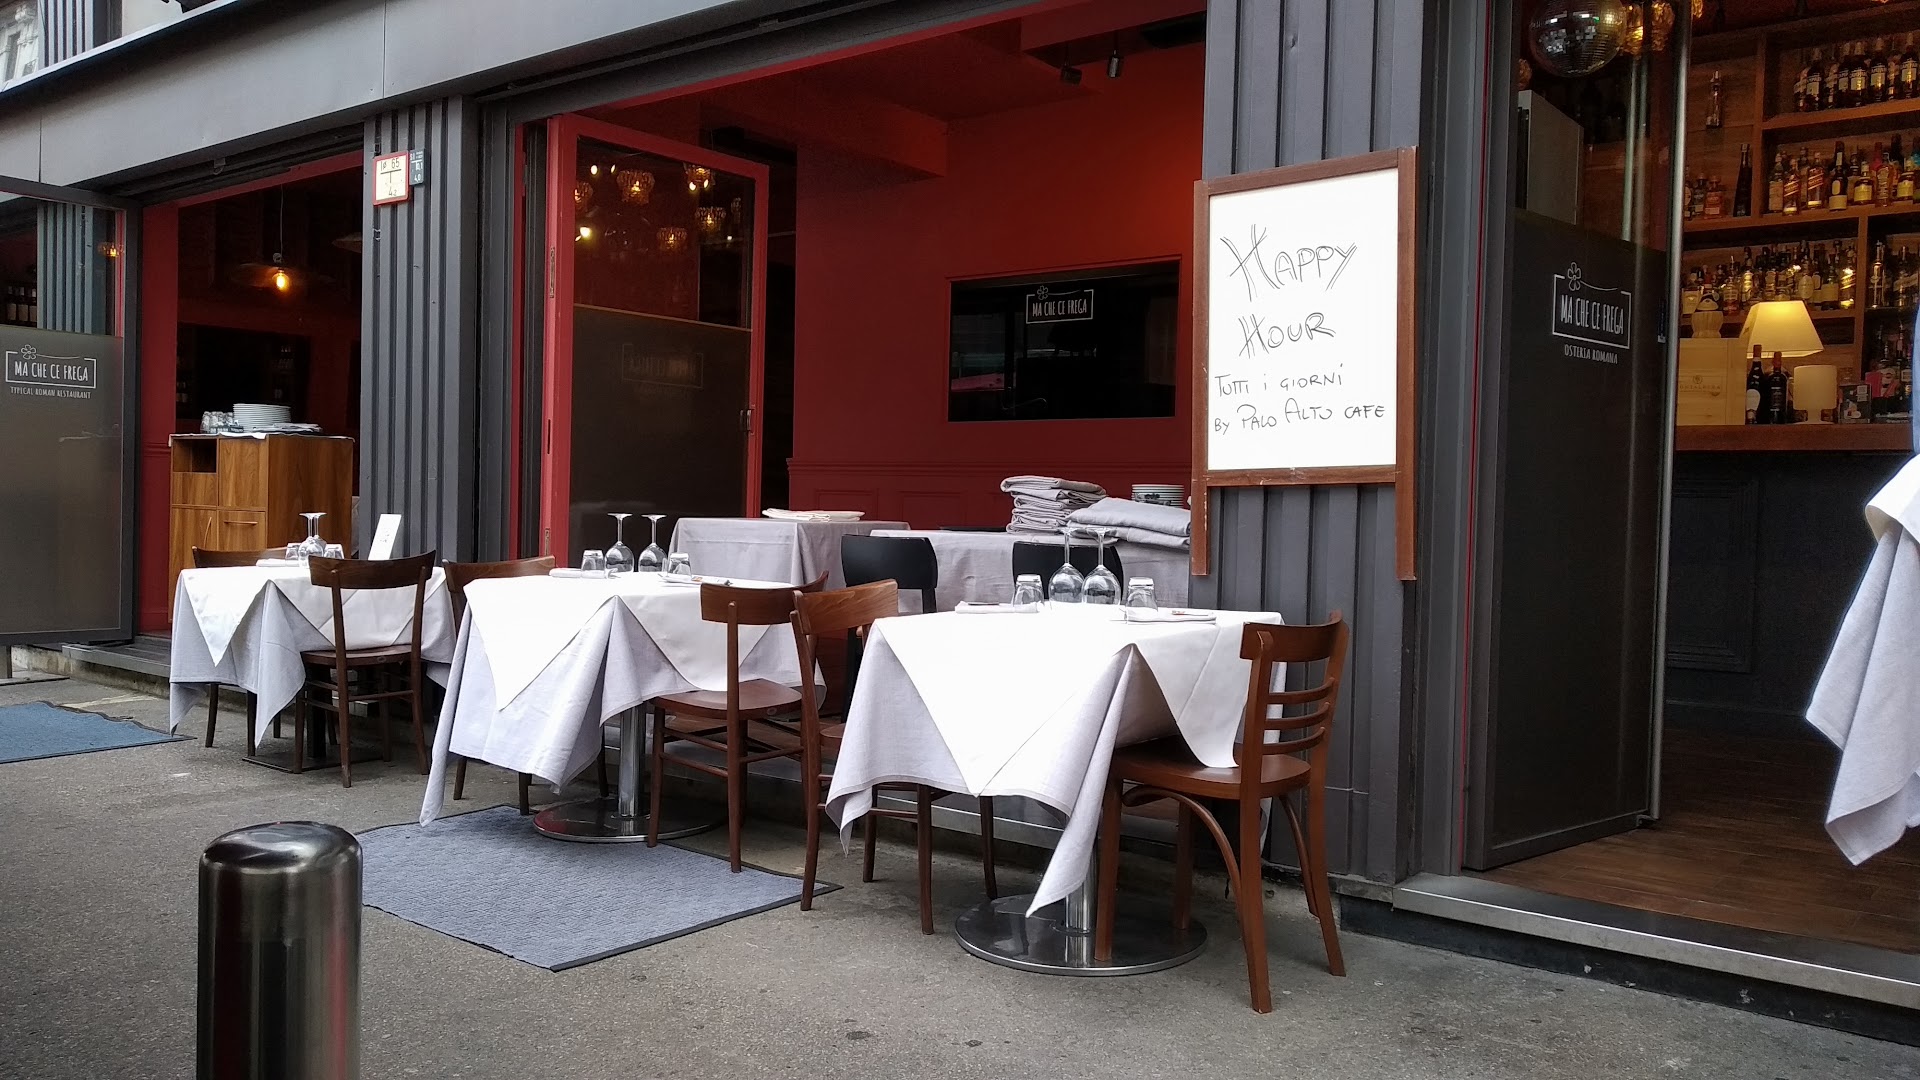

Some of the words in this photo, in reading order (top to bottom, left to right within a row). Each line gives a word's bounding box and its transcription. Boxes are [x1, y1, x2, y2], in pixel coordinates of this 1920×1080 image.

[391, 158, 400, 169] 65
[1032, 302, 1043, 317] MA
[1044, 301, 1056, 316] CHE
[1057, 300, 1066, 315] CE
[1067, 298, 1087, 314] FREGA
[1560, 294, 1573, 324] MA
[1575, 298, 1590, 328] CHE
[1591, 301, 1601, 330] CE
[1602, 304, 1624, 334] FREGA
[1237, 311, 1337, 359] HOUR
[1564, 344, 1591, 360] OSTERIA
[1592, 349, 1618, 364] ROMANA
[14, 361, 28, 377] MA
[31, 362, 47, 378] CHE
[50, 364, 60, 379] CE
[63, 365, 89, 381] FREGA
[10, 386, 34, 396] TYPICAL
[35, 388, 56, 397] ROMAN
[57, 390, 91, 399] RESTAURANT
[1285, 397, 1333, 424] ALTO
[1344, 404, 1386, 420] CAFE
